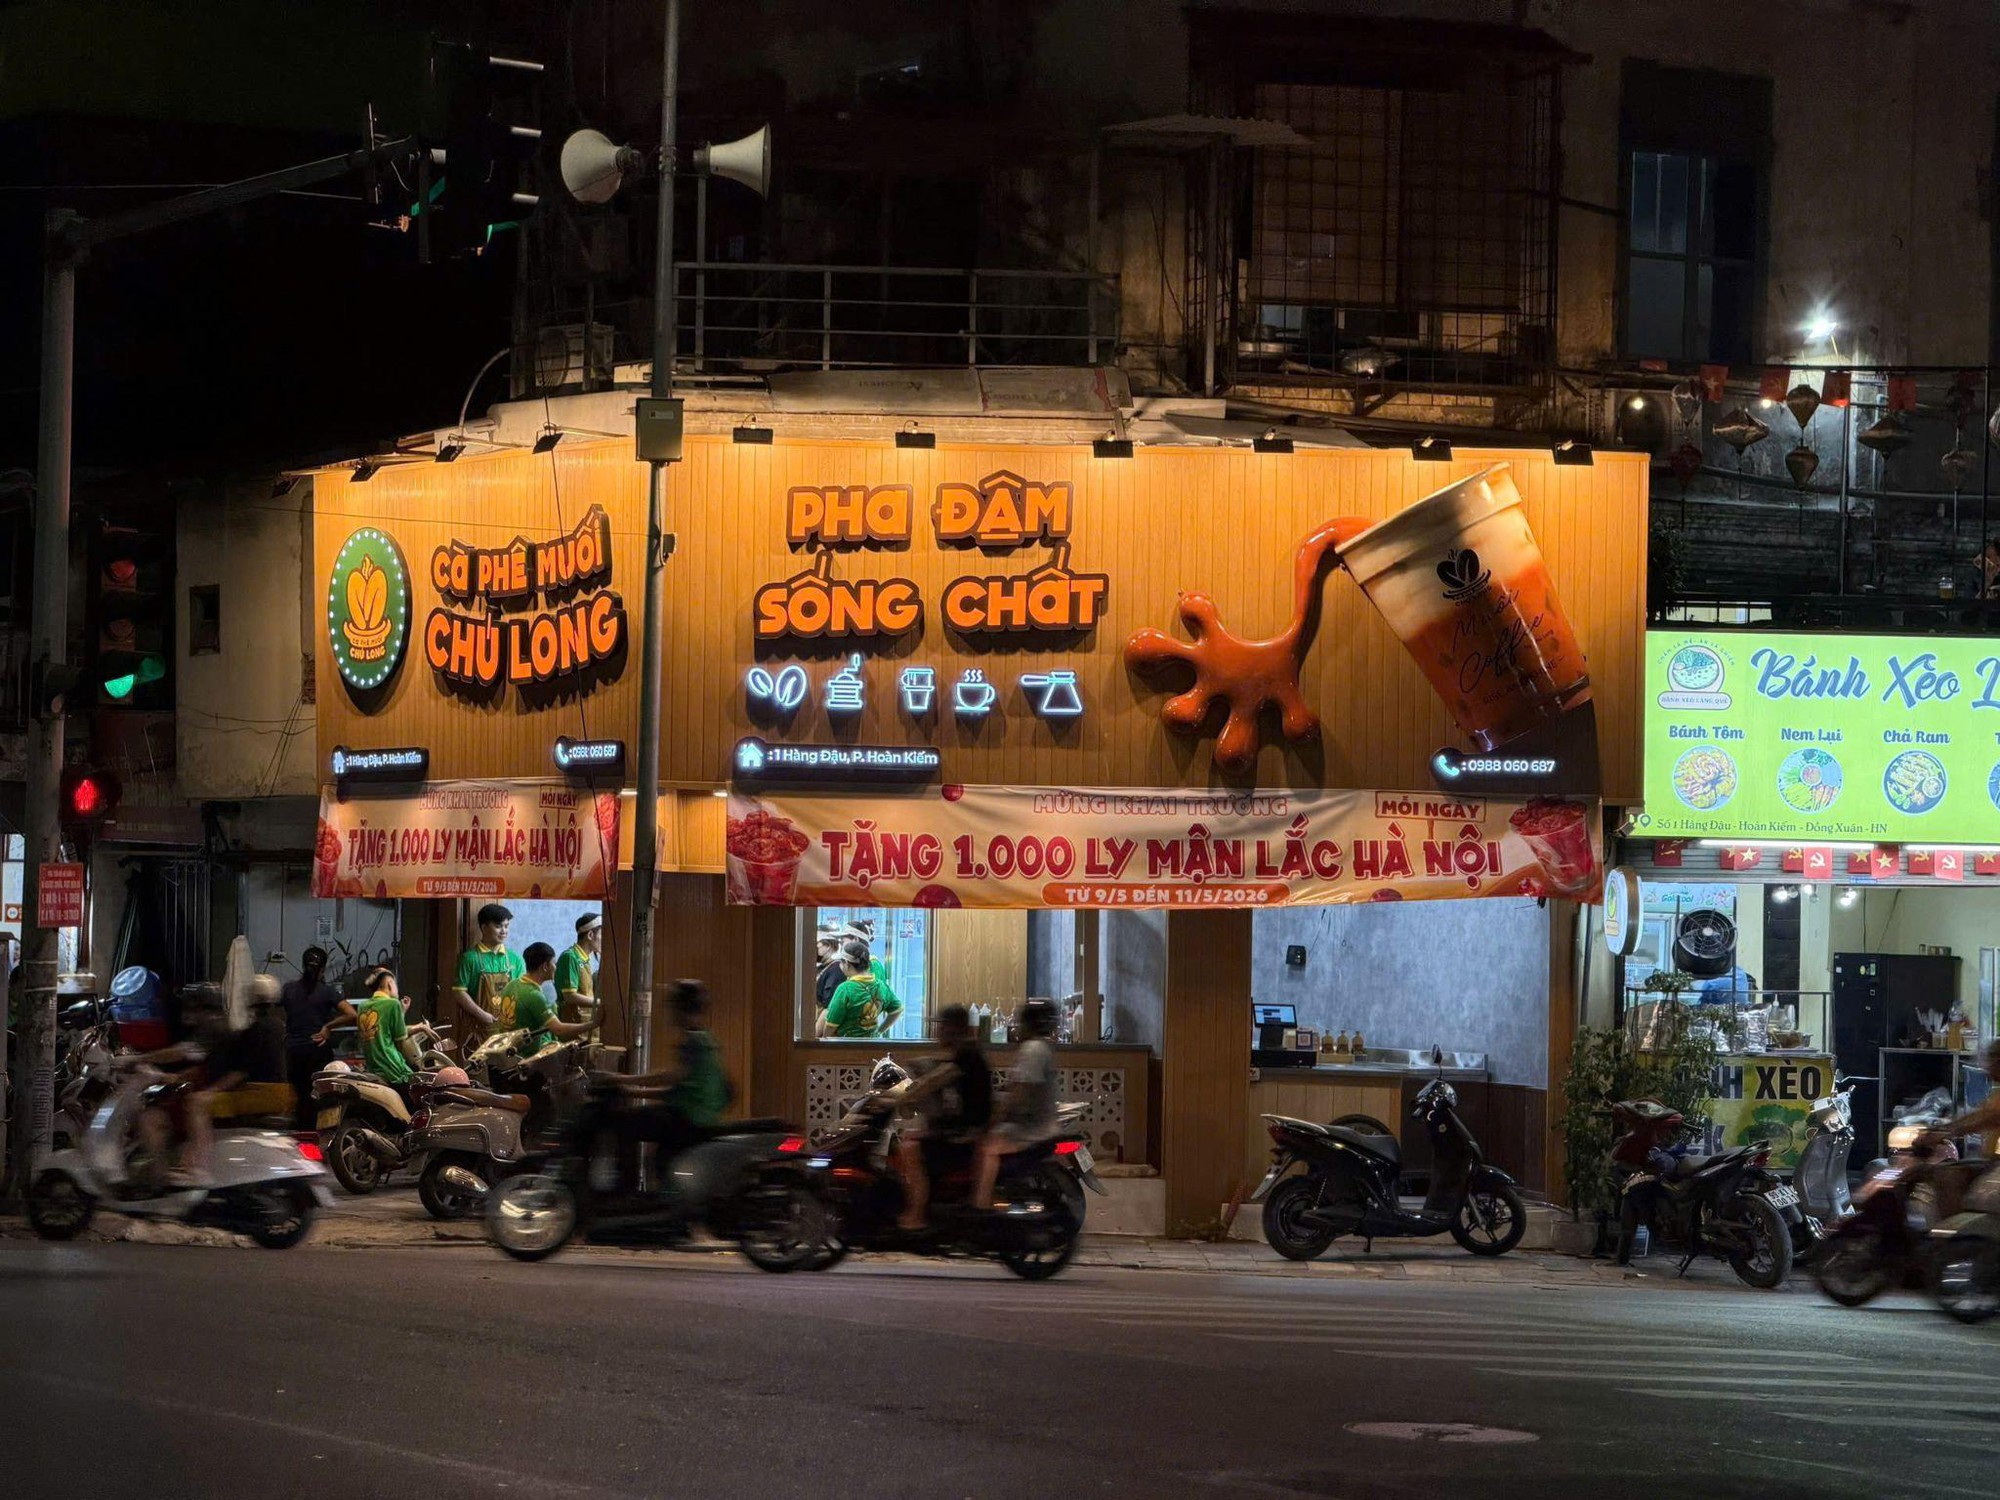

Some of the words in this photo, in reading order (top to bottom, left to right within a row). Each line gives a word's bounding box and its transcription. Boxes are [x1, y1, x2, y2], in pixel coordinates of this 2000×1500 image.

[937, 477, 1069, 540] ĐẬM
[479, 544, 527, 590] PHÊ
[537, 512, 602, 586] MUỐI
[758, 554, 918, 633] SỐNG
[511, 596, 618, 679] LONG
[1751, 649, 1870, 698] Bánh
[1883, 654, 1960, 709] Xèo
[1669, 726, 1708, 738] Bánh
[1712, 726, 1744, 739] Tôm
[1781, 728, 1814, 741] Nem
[1818, 729, 1843, 744] Lụi
[1883, 729, 1912, 743] Chả
[1916, 731, 1950, 743] Ram
[783, 748, 817, 764] Hàng
[820, 750, 850, 764] Đậu,
[853, 752, 864, 763] P.
[868, 750, 900, 763] Hoàn
[904, 748, 938, 764] Kiếm
[1504, 760, 1528, 771] 060
[1531, 760, 1555, 771] 687
[446, 791, 470, 809] KHAI
[1033, 792, 1107, 814] MỪNG
[1113, 796, 1177, 815] KHAI
[1183, 794, 1288, 816] TRƯƠNG
[1382, 796, 1419, 815] MỖI
[1425, 801, 1480, 819] NGÀY
[1656, 818, 1671, 829] Số
[1673, 821, 1677, 829] 1
[1680, 820, 1708, 831] Hàng
[1710, 821, 1731, 832] Đậu
[1739, 821, 1767, 831] Hoàn
[1769, 820, 1796, 832] Kiếm
[1871, 823, 1888, 833] HN
[349, 819, 385, 874] TẶNG
[390, 829, 430, 863] 1.000
[433, 829, 451, 864] LY
[456, 815, 491, 869] MẬN
[494, 807, 526, 863] LẮC
[529, 815, 550, 865] HÀ
[554, 813, 583, 883] NỘI
[821, 819, 943, 889] TẶNG
[953, 834, 1075, 879] 1.000
[1084, 835, 1137, 880] LY
[1146, 822, 1248, 884] MẬN
[1255, 813, 1342, 880] LẮC
[1353, 821, 1415, 879] HÀ
[1423, 824, 1501, 889] NỘI
[1065, 886, 1090, 902] TỪ
[1095, 889, 1127, 902] 9/5
[1132, 885, 1169, 903] ĐẾN
[1176, 889, 1268, 903] 11/5/2026
[1756, 1060, 1821, 1101] XÈO
